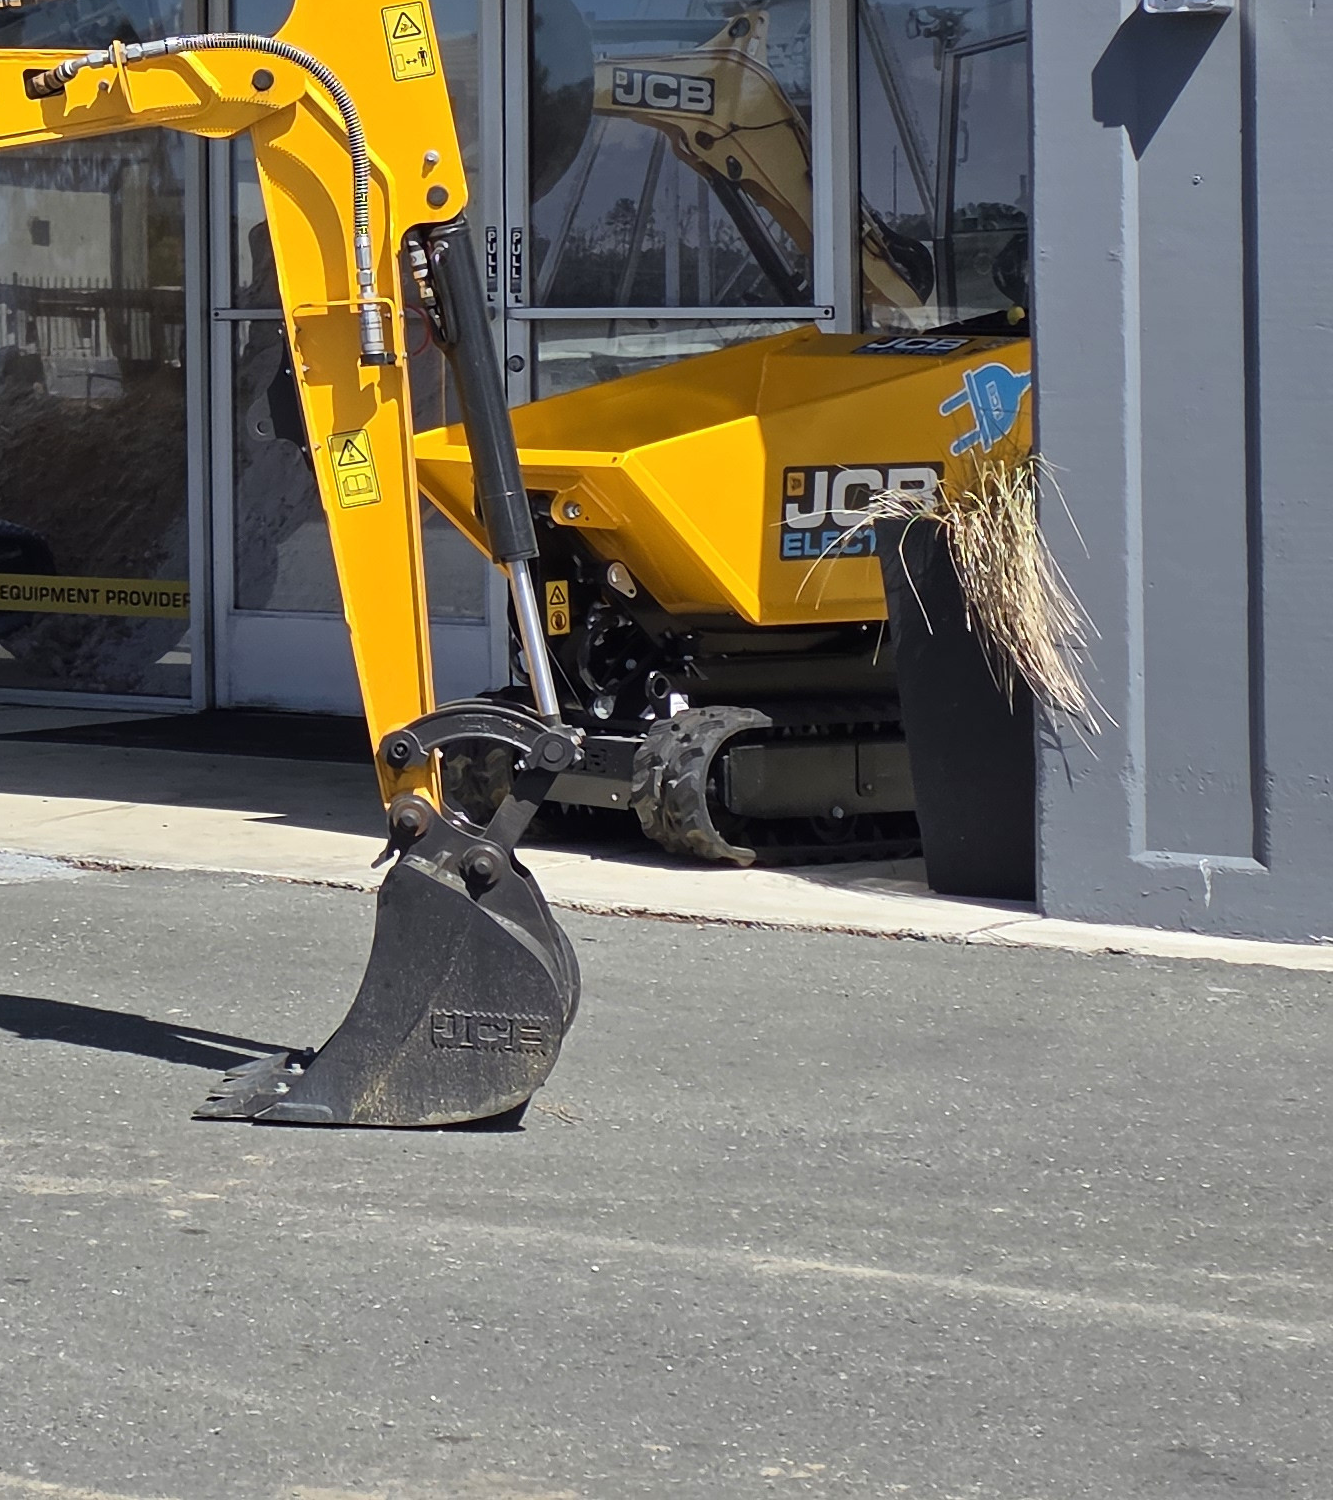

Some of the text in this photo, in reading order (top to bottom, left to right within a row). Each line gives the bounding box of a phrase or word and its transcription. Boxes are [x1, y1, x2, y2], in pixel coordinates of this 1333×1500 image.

[615, 72, 712, 111] JCB
[487, 231, 496, 277] PULL
[512, 232, 520, 278] PULL
[866, 337, 970, 350] JCB
[785, 467, 938, 528] JCB
[783, 529, 877, 557] ELECT
[0, 585, 99, 605] EQUIPMENT
